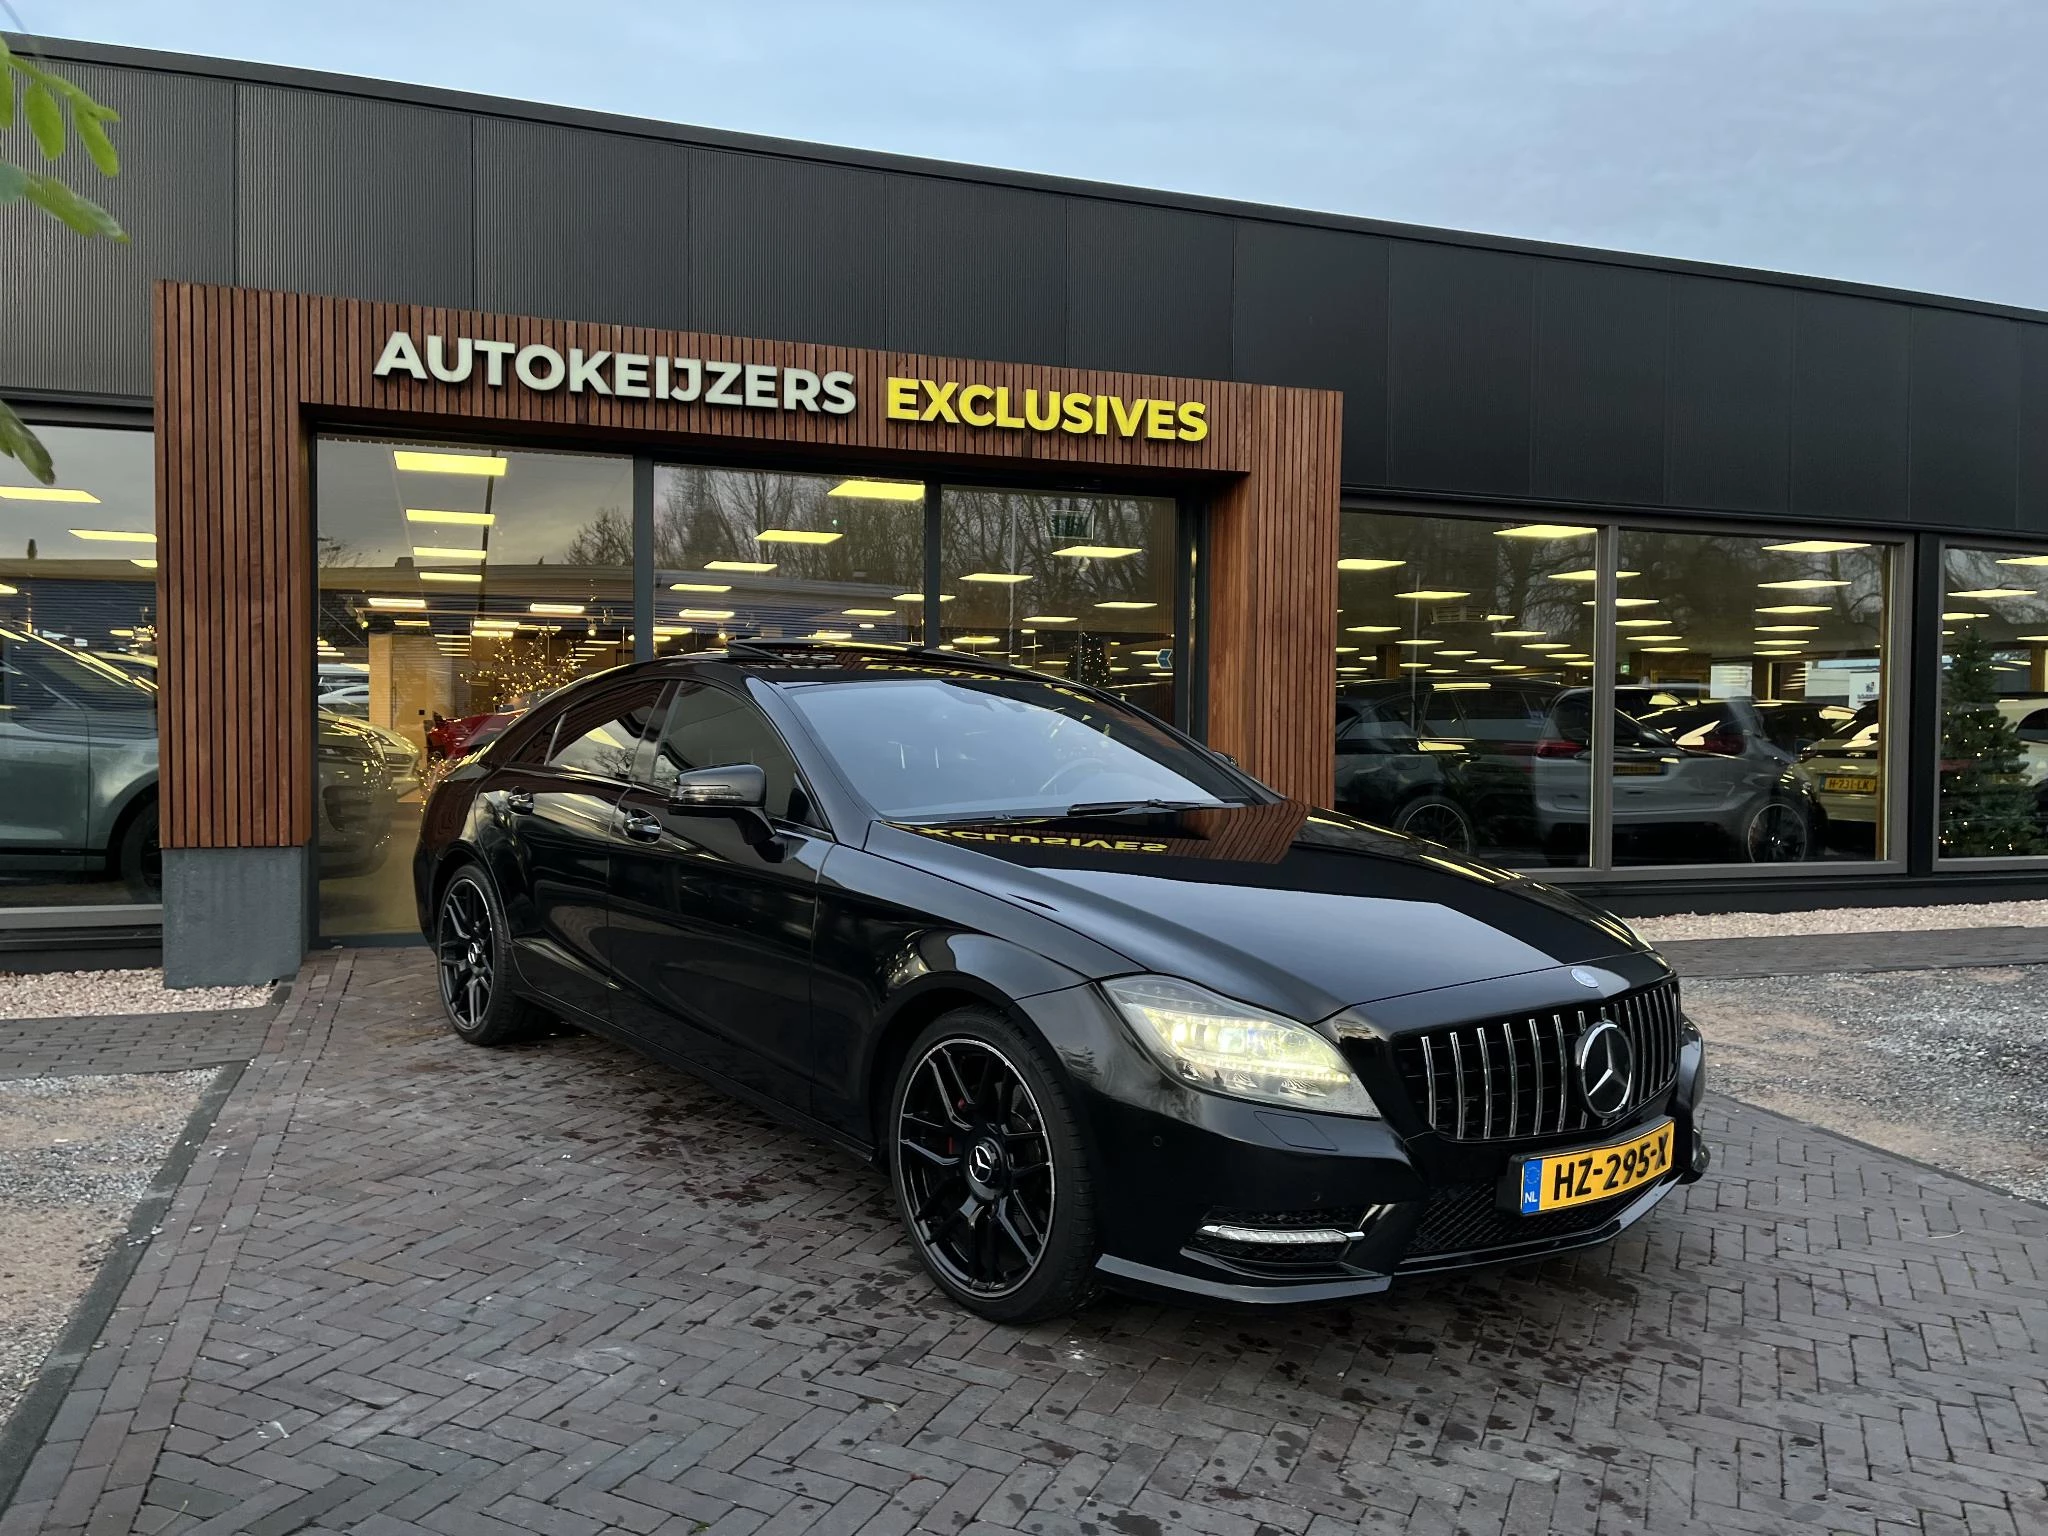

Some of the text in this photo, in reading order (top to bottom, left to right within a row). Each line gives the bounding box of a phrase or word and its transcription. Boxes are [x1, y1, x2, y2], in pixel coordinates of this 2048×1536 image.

[372, 331, 1209, 442] AUTOKEIJZERS EXCLUSIVES
[1524, 1191, 1538, 1204] NL
[1553, 1131, 1670, 1201] HZ-295-X
